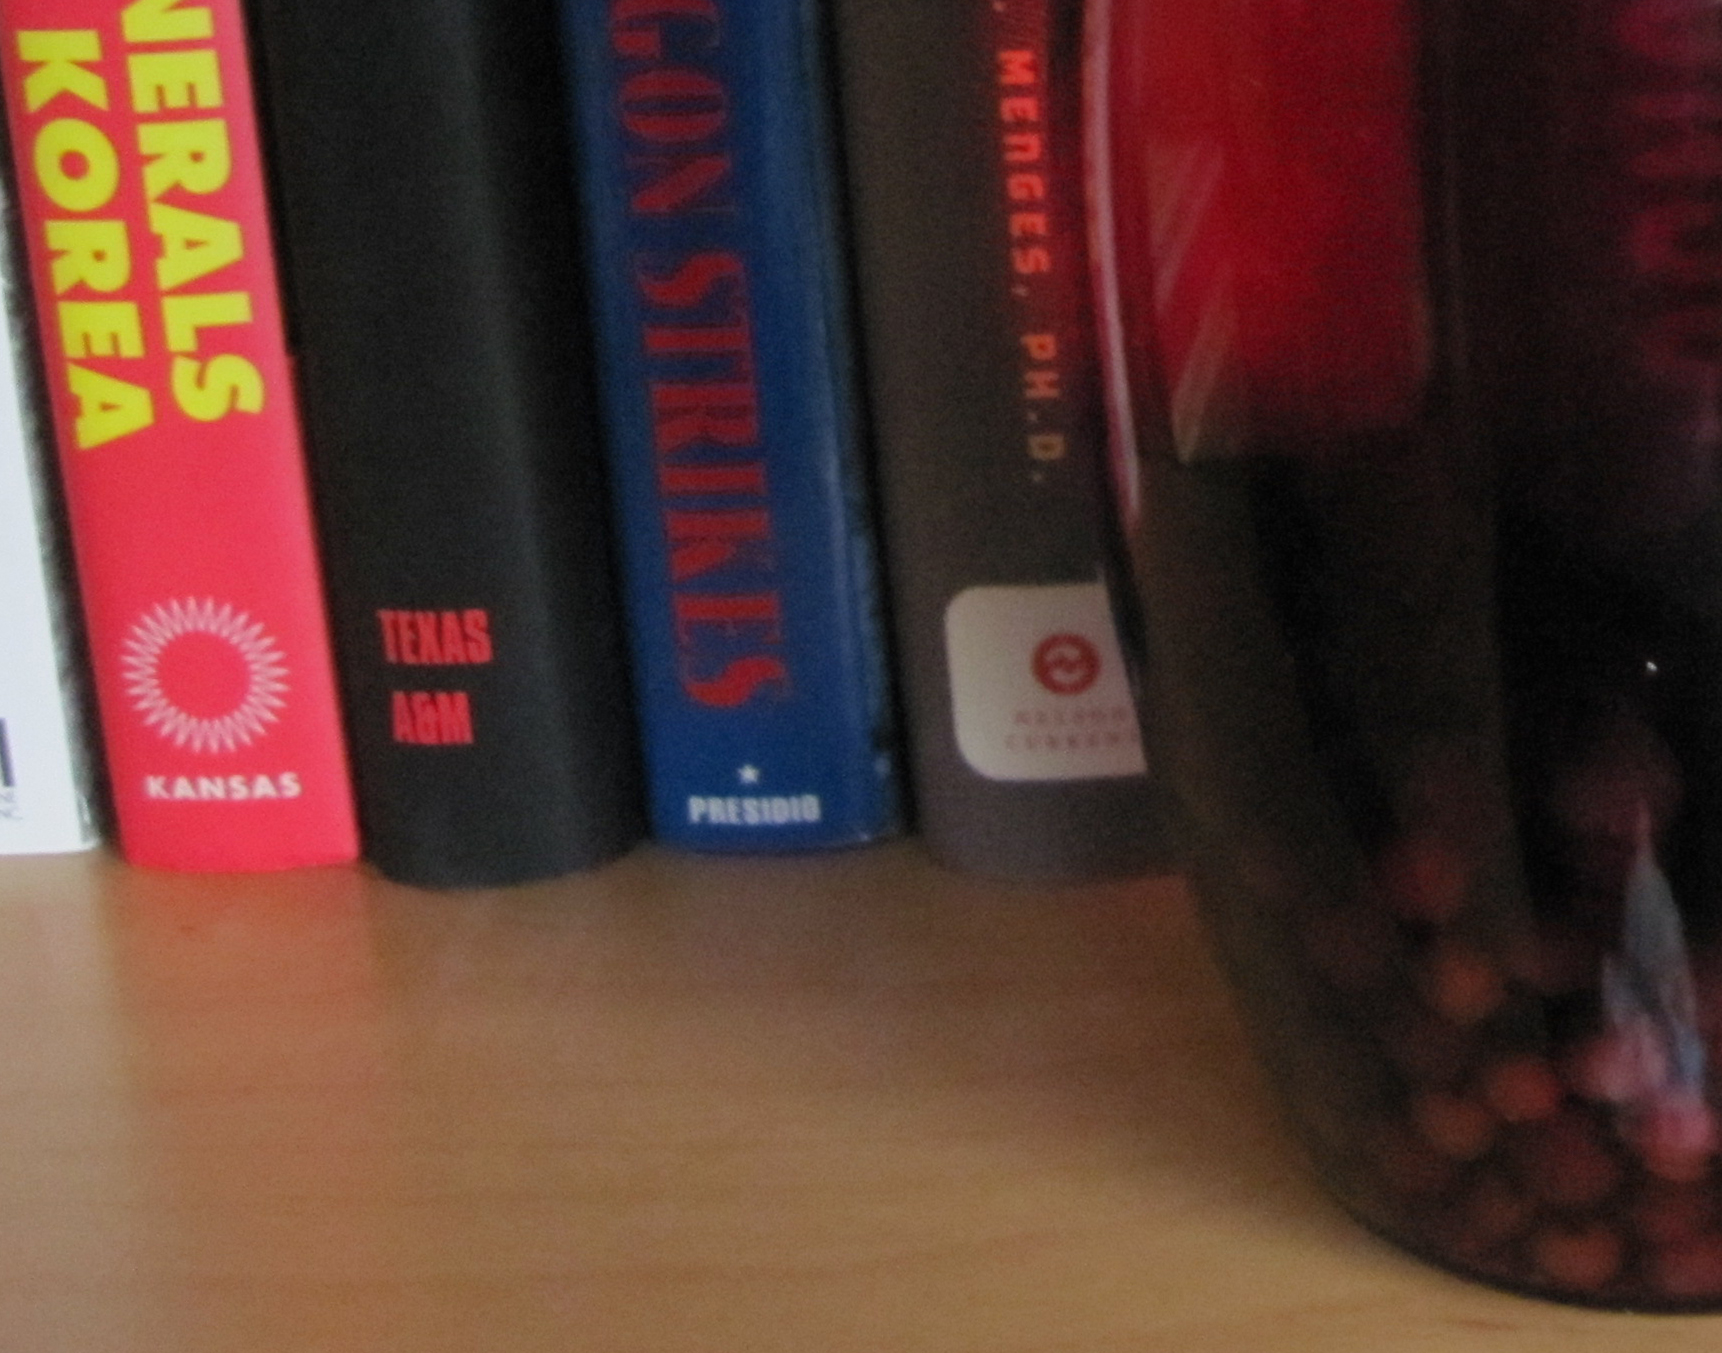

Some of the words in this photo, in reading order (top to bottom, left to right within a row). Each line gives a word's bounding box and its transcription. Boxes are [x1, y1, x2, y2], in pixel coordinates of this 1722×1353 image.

[16, 28, 155, 451] KOREA
[631, 250, 796, 709] STRIKES
[377, 608, 493, 665] TEXAS
[390, 690, 474, 744] A&M
[144, 771, 304, 802] KANSAS
[687, 793, 822, 826] PRESIDIO
